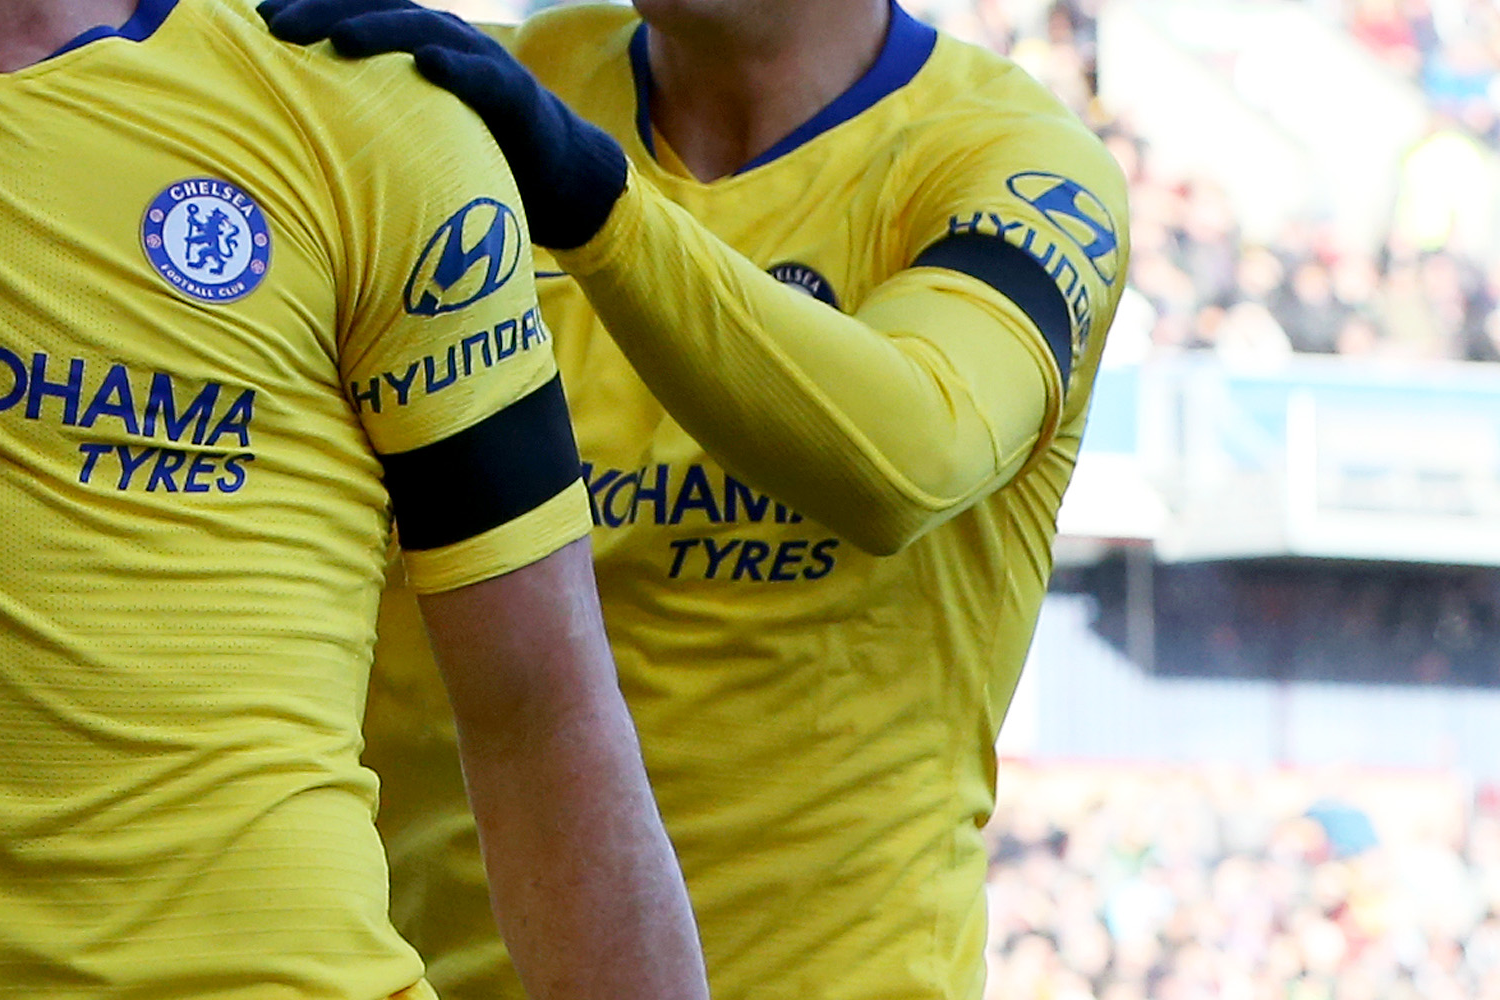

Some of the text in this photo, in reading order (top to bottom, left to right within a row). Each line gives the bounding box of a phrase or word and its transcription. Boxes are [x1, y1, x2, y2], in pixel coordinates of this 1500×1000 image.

[170, 181, 254, 217] CHELSEA
[160, 263, 246, 298] FOOTBALL CLUB
[949, 212, 1090, 347] HYUNDA
[350, 306, 547, 414] HYUNDAI
[79, 443, 256, 493] TYRES
[668, 538, 840, 582] TYRES
